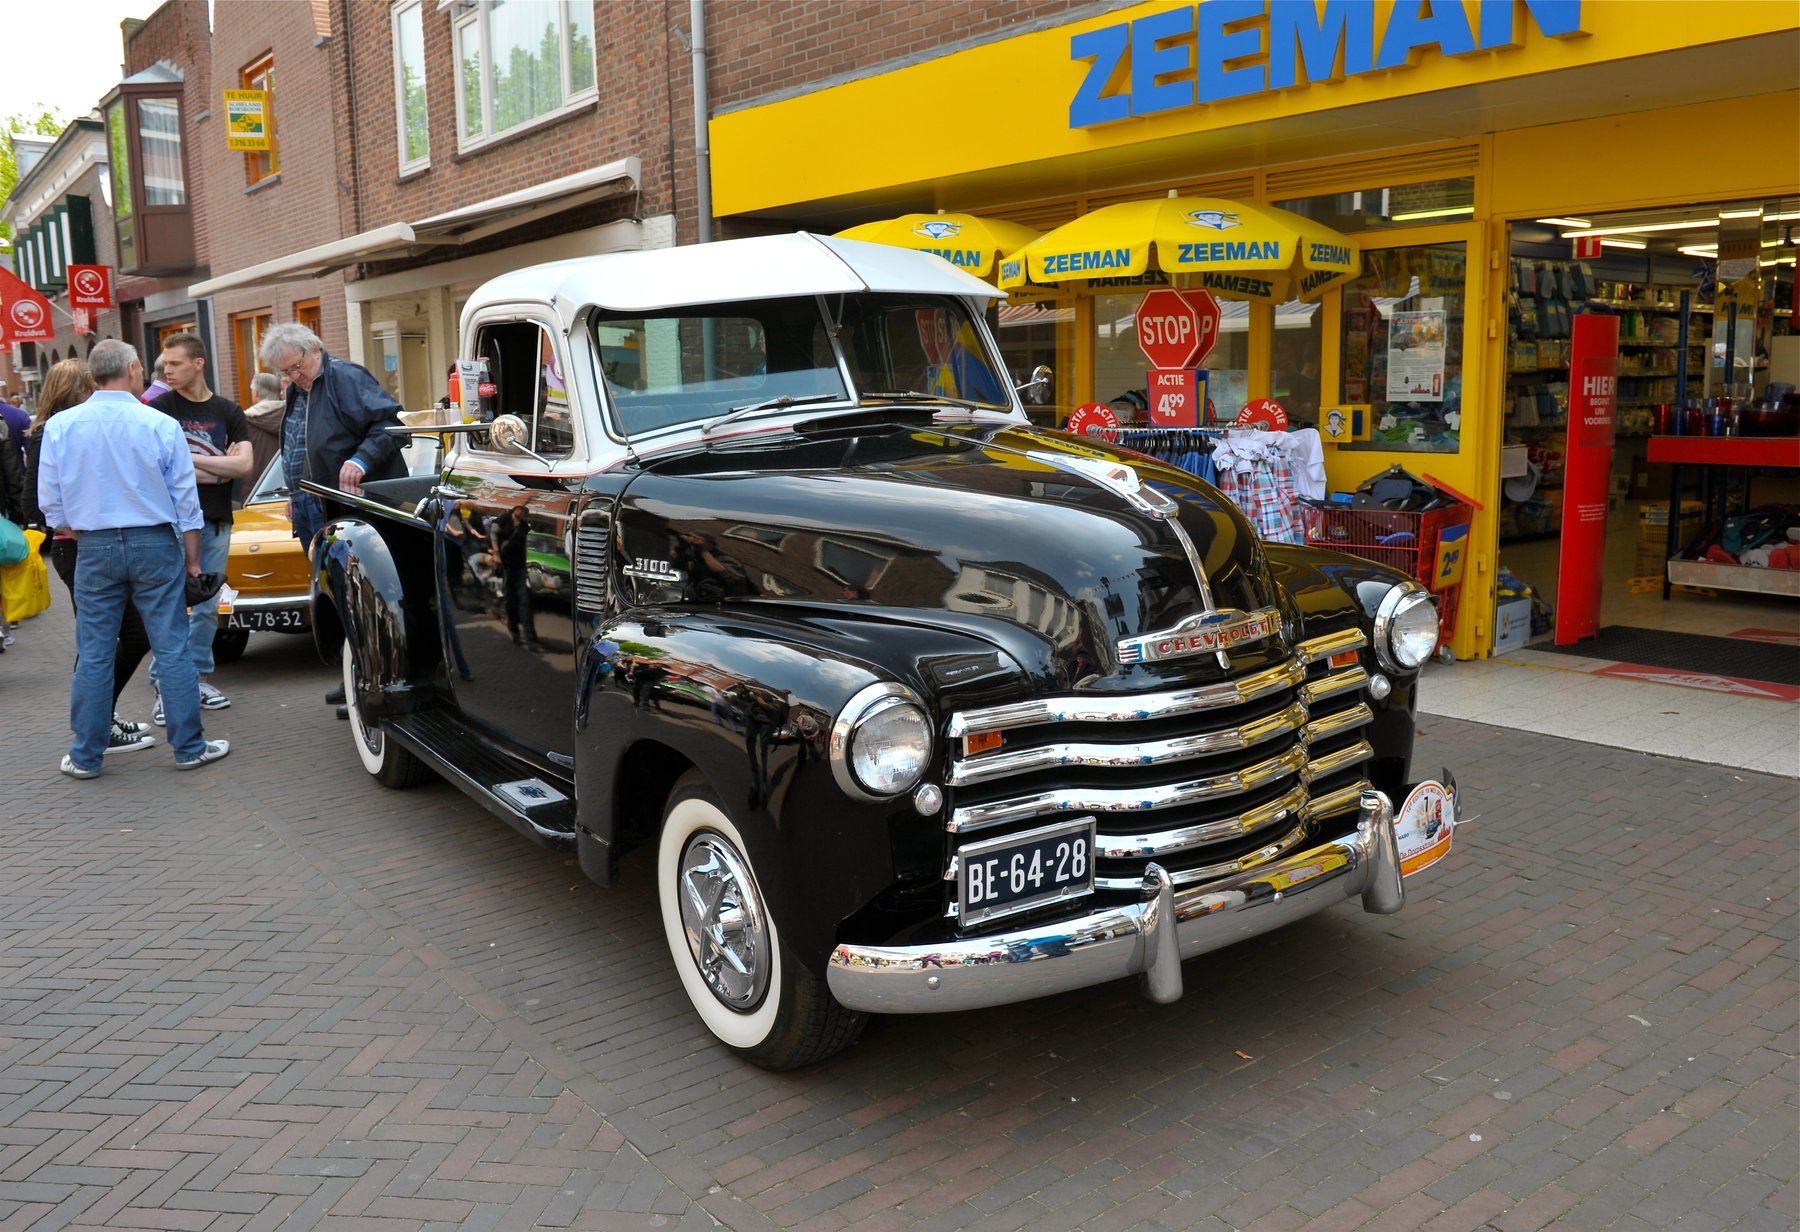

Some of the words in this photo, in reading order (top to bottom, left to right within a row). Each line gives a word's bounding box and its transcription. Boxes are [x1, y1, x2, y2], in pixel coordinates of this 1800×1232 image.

[225, 91, 235, 99] TE
[1044, 248, 1130, 274] ZEEMAN
[1178, 241, 1279, 263] ZEEMAN
[1310, 243, 1351, 265] ZEEMAN
[14, 329, 47, 337] Kruidvat
[1142, 315, 1191, 345] STOP
[1157, 375, 1184, 385] ACTIE
[1583, 376, 1615, 396] HIER
[1590, 398, 1610, 406] BEGINT
[1261, 401, 1286, 425] ACTIE
[635, 557, 669, 573] 3100
[227, 611, 302, 628] AL-78-32
[1158, 620, 1268, 654] CHEVROLET
[968, 838, 1087, 904] BE-64-28
